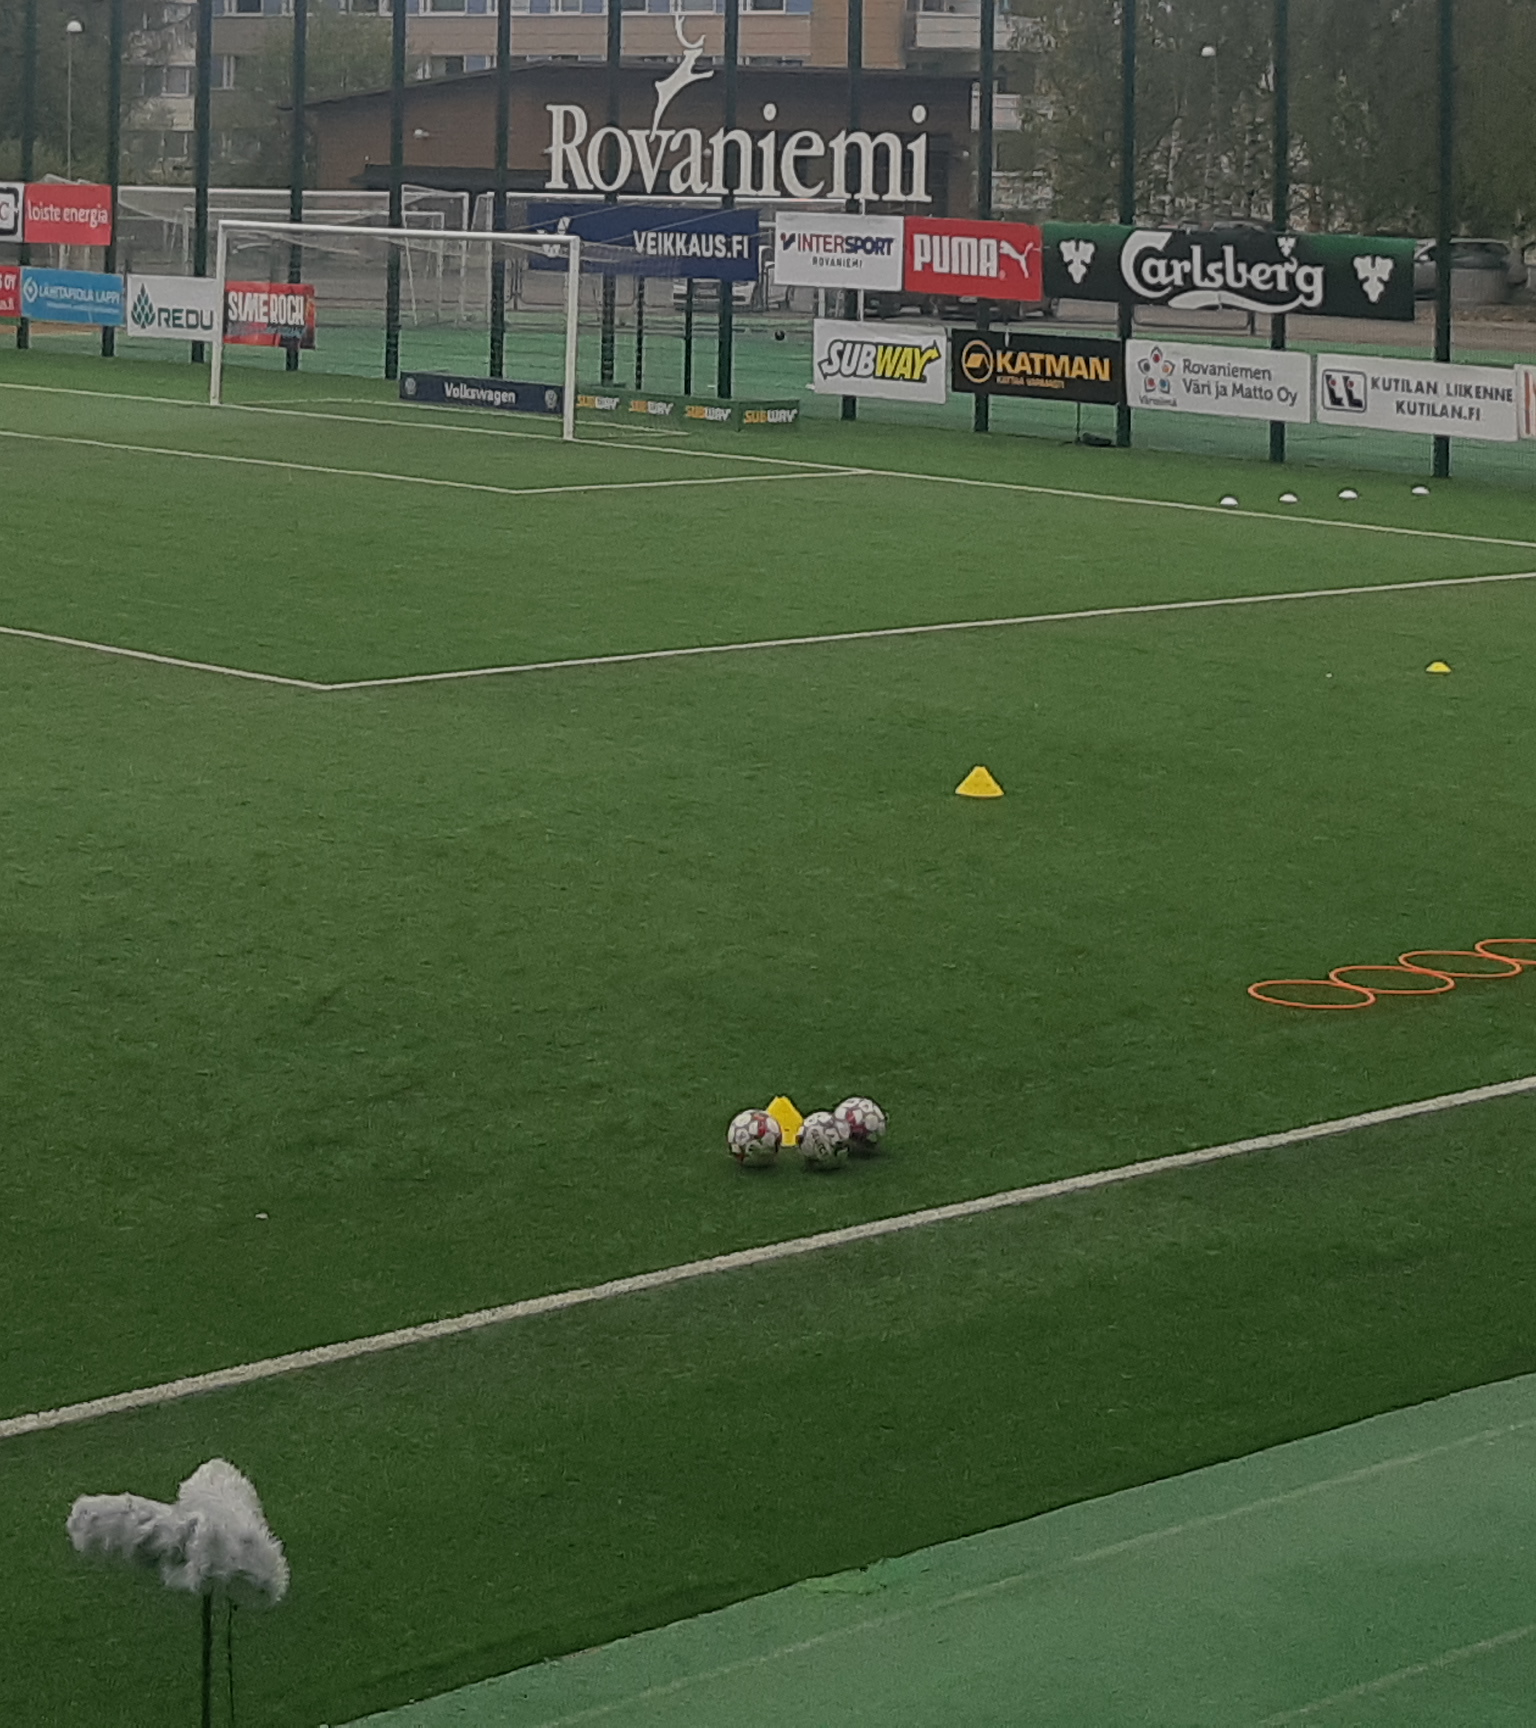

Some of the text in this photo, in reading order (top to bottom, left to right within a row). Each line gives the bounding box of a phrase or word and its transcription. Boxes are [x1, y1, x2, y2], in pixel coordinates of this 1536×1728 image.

[545, 103, 932, 203] Rovaniemi
[27, 200, 108, 228] loiste energia
[633, 229, 750, 260] VEIKKAUS.FI
[797, 232, 895, 256] INTERSPORT
[913, 233, 997, 278] PUMA
[1120, 229, 1325, 313] Carlsberg
[157, 307, 214, 330] REDU
[822, 339, 940, 383] SUBWAY
[996, 350, 1111, 382] KATMAN
[1182, 358, 1272, 381] Rovaniemen
[444, 381, 516, 405] Volkswagen
[1182, 377, 1299, 407] Väri ja Matto Oy
[1370, 376, 1513, 403] KUTILAN LIIKENNE
[1395, 400, 1481, 421] KUTILAN.FI
